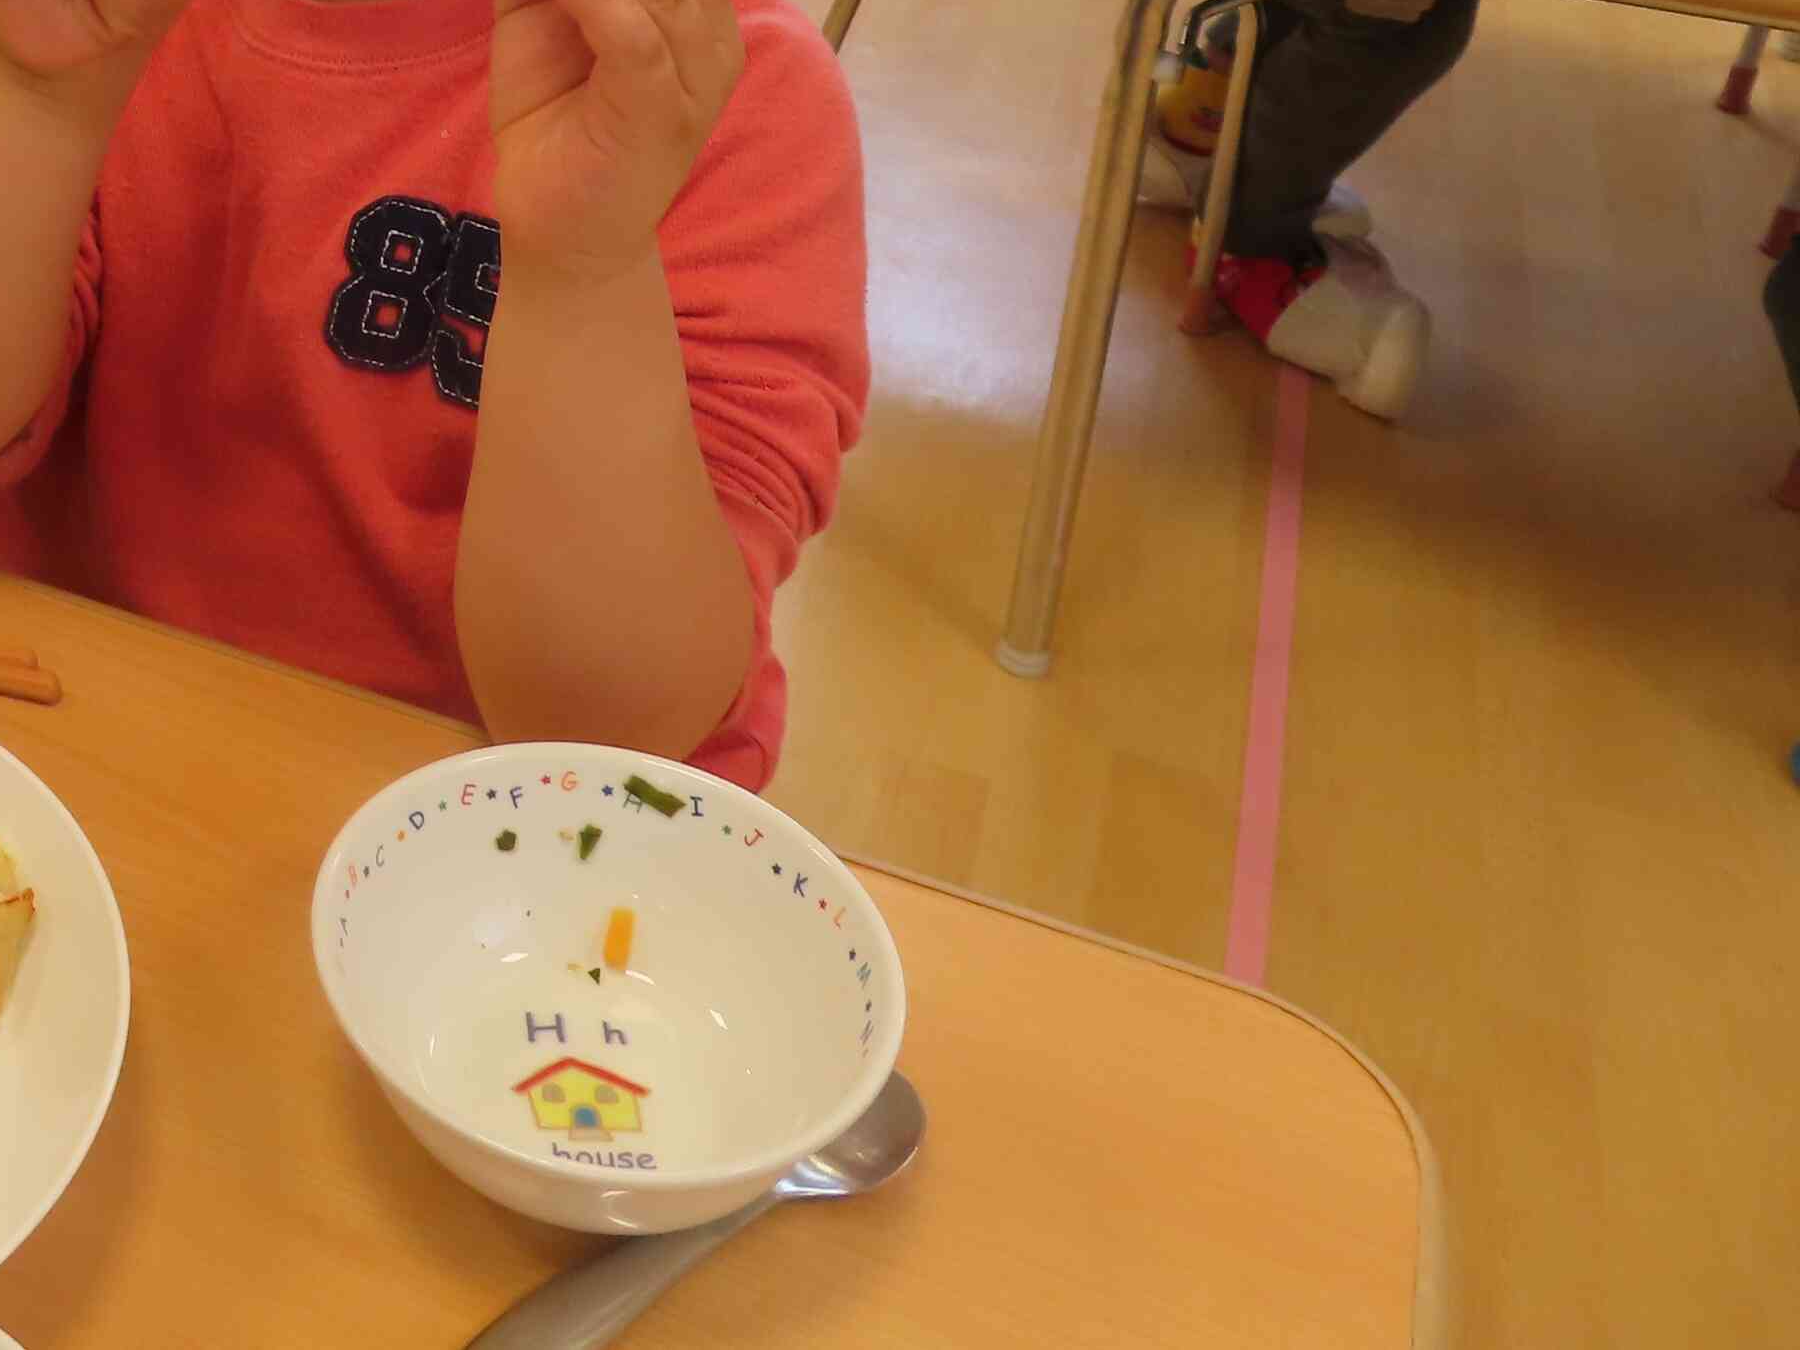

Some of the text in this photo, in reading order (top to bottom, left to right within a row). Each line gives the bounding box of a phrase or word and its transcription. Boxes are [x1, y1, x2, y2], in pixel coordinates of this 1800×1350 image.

[324, 195, 500, 414] 85
[409, 811, 425, 830] D
[461, 783, 477, 806] E
[510, 786, 524, 809] F
[561, 771, 579, 792] G
[690, 795, 704, 818] I
[744, 828, 764, 846] J
[793, 873, 809, 898] K
[526, 1011, 628, 1046] H h
[552, 1141, 658, 1170] house
